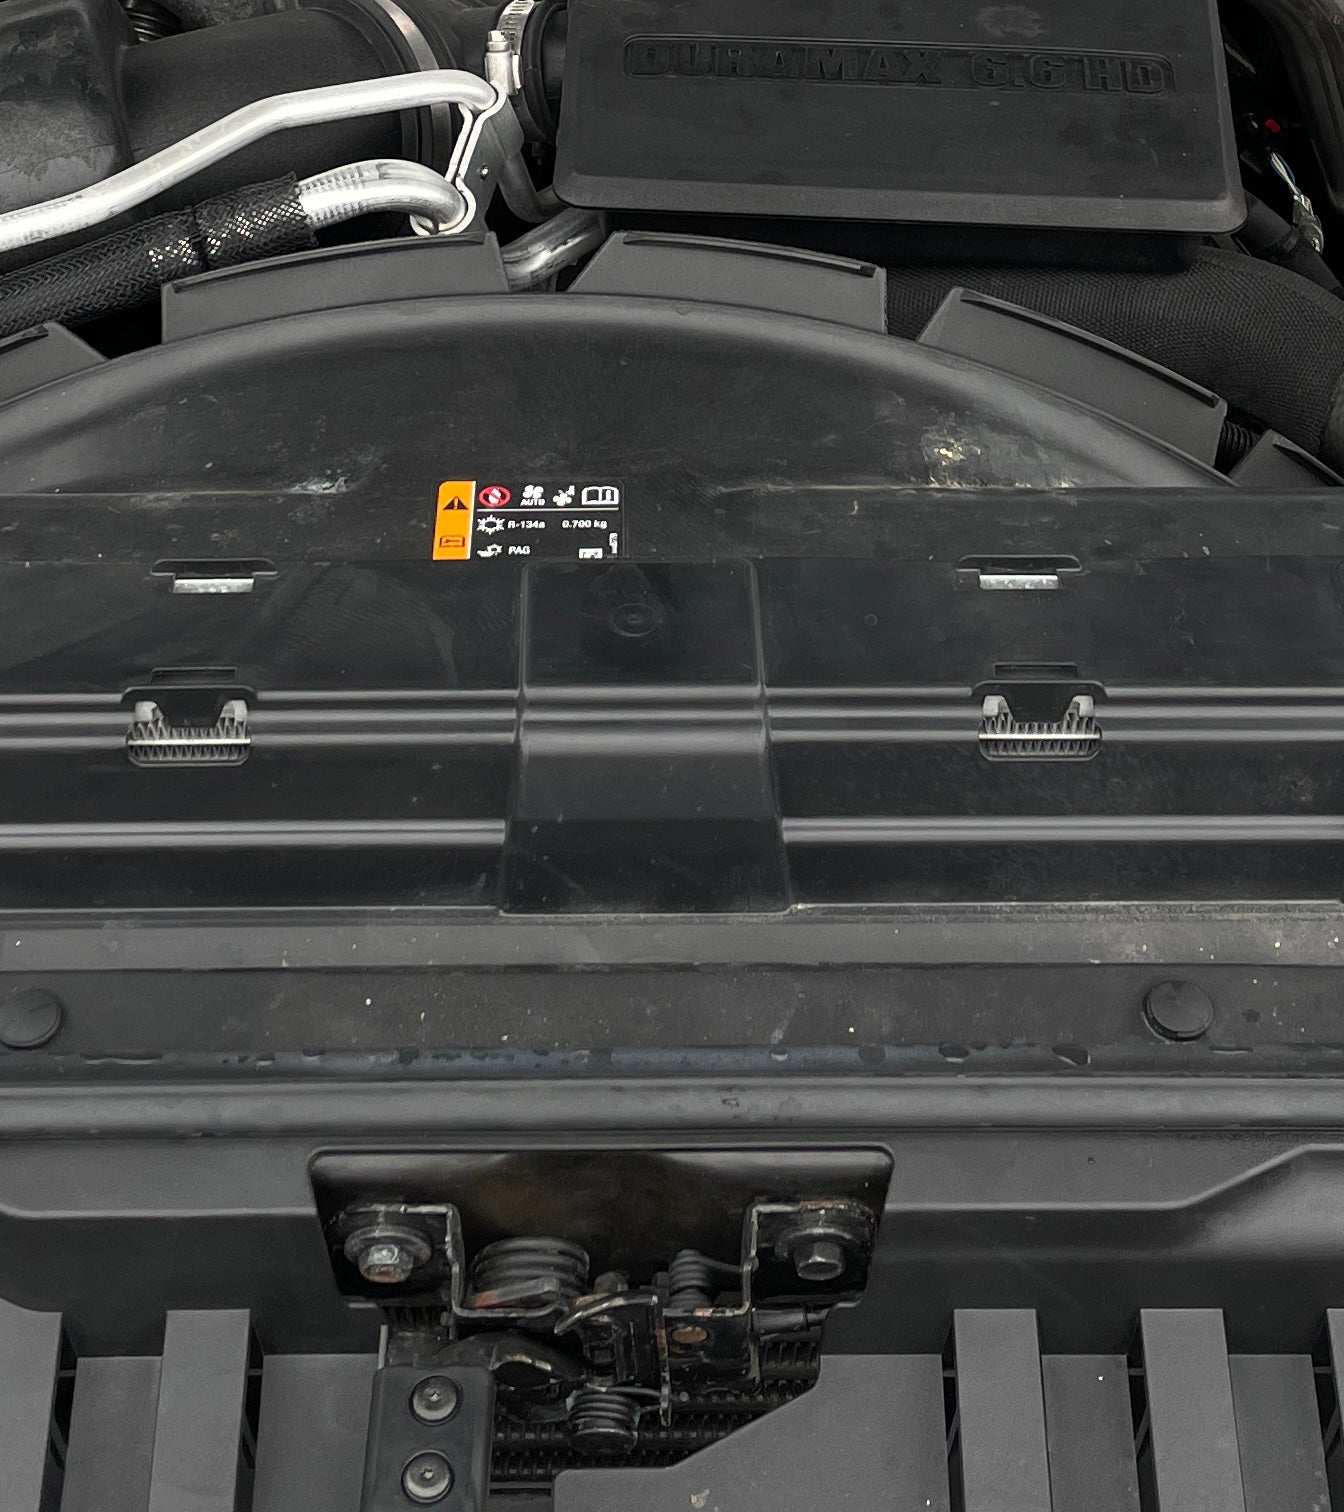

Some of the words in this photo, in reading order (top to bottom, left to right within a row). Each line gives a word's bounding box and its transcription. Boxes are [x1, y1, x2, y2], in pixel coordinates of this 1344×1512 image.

[630, 42, 943, 85] DURAMAX
[968, 50, 1067, 89] 6.6
[1083, 54, 1167, 94] HD
[520, 498, 545, 506] AUTO
[507, 520, 545, 529] R-134a
[562, 519, 591, 529] 0.700
[593, 519, 607, 529] kg
[508, 545, 531, 555] PAG
